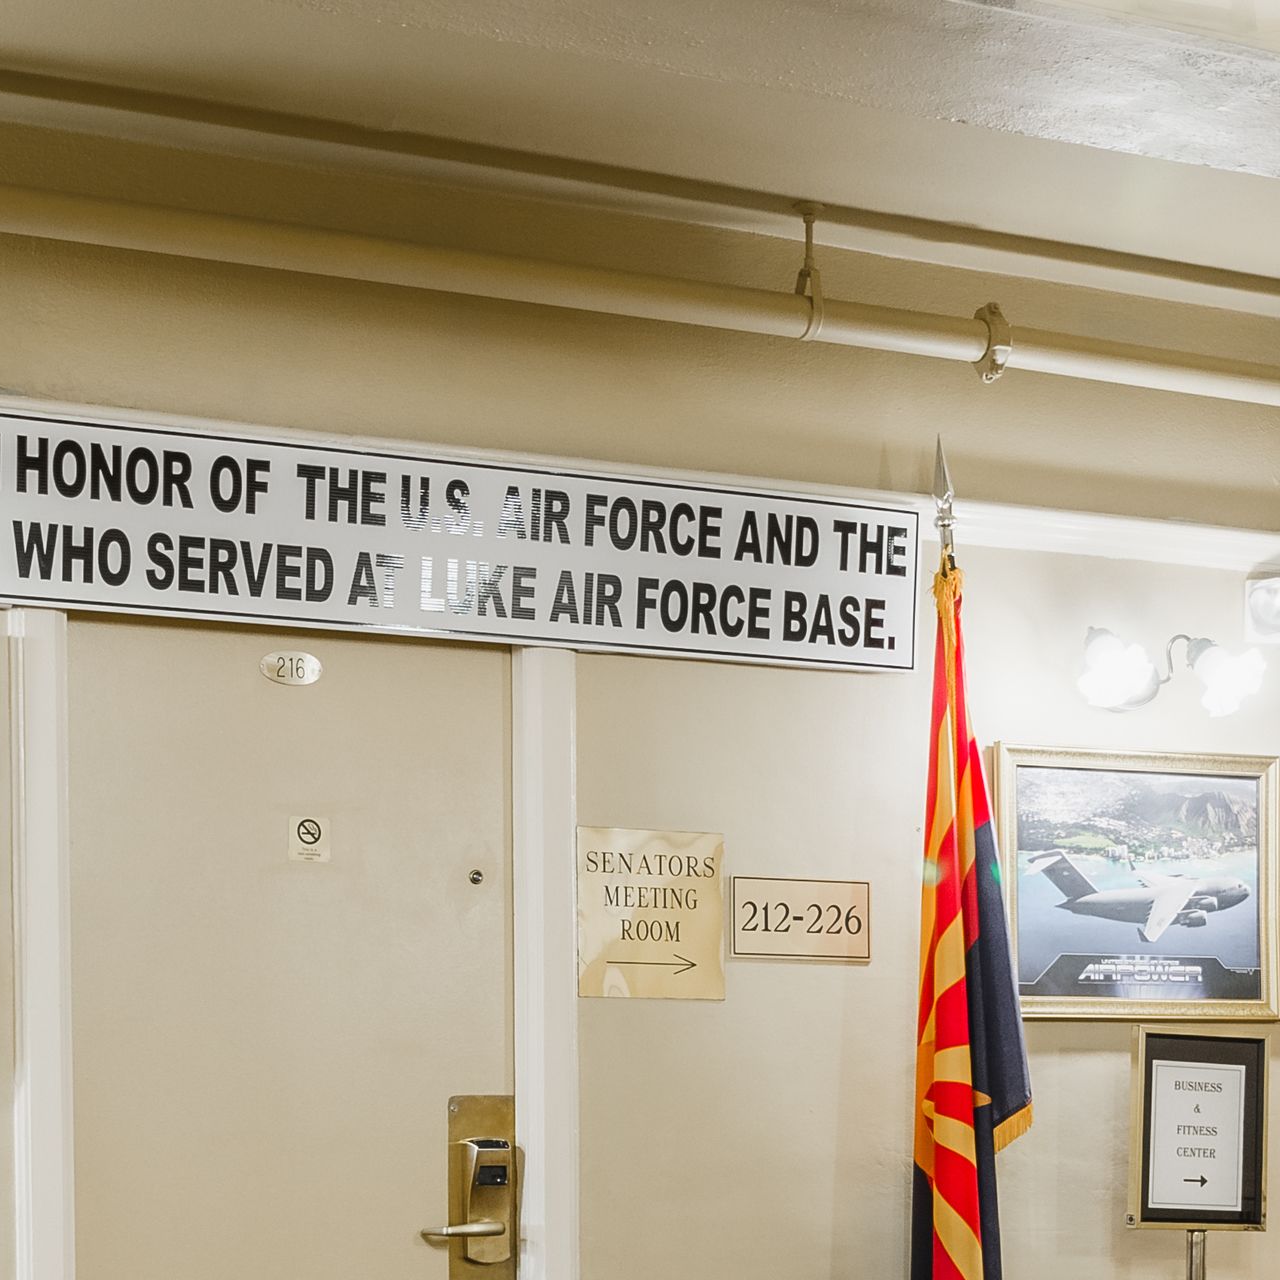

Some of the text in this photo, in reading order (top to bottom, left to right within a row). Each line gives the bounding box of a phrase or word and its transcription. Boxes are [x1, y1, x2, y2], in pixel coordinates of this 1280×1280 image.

[16, 434, 195, 509] HONOR
[209, 455, 271, 515] OF
[296, 463, 388, 527] THE
[400, 474, 484, 537] U.S.
[495, 485, 572, 545] AIR
[583, 493, 723, 559] FORCE
[733, 510, 820, 567] AND
[833, 519, 908, 577] THE
[12, 520, 132, 587] WHO
[145, 532, 335, 602] SERVED
[347, 551, 405, 608] AT
[419, 556, 538, 621] LUKE
[549, 569, 623, 628] AIR
[635, 576, 772, 640] FORCE
[782, 590, 896, 651] BASE.
[276, 656, 306, 679] 216
[585, 851, 716, 879] SENATORS
[603, 885, 698, 910] MEETING
[740, 901, 863, 935] 212-226
[619, 919, 681, 943] ROOM
[1078, 964, 1203, 981] AIRPOWER
[1173, 1080, 1223, 1093] BUSINESS
[1192, 1103, 1202, 1114] &
[1175, 1124, 1218, 1137] FITNESS
[1175, 1147, 1216, 1159] CENTER
